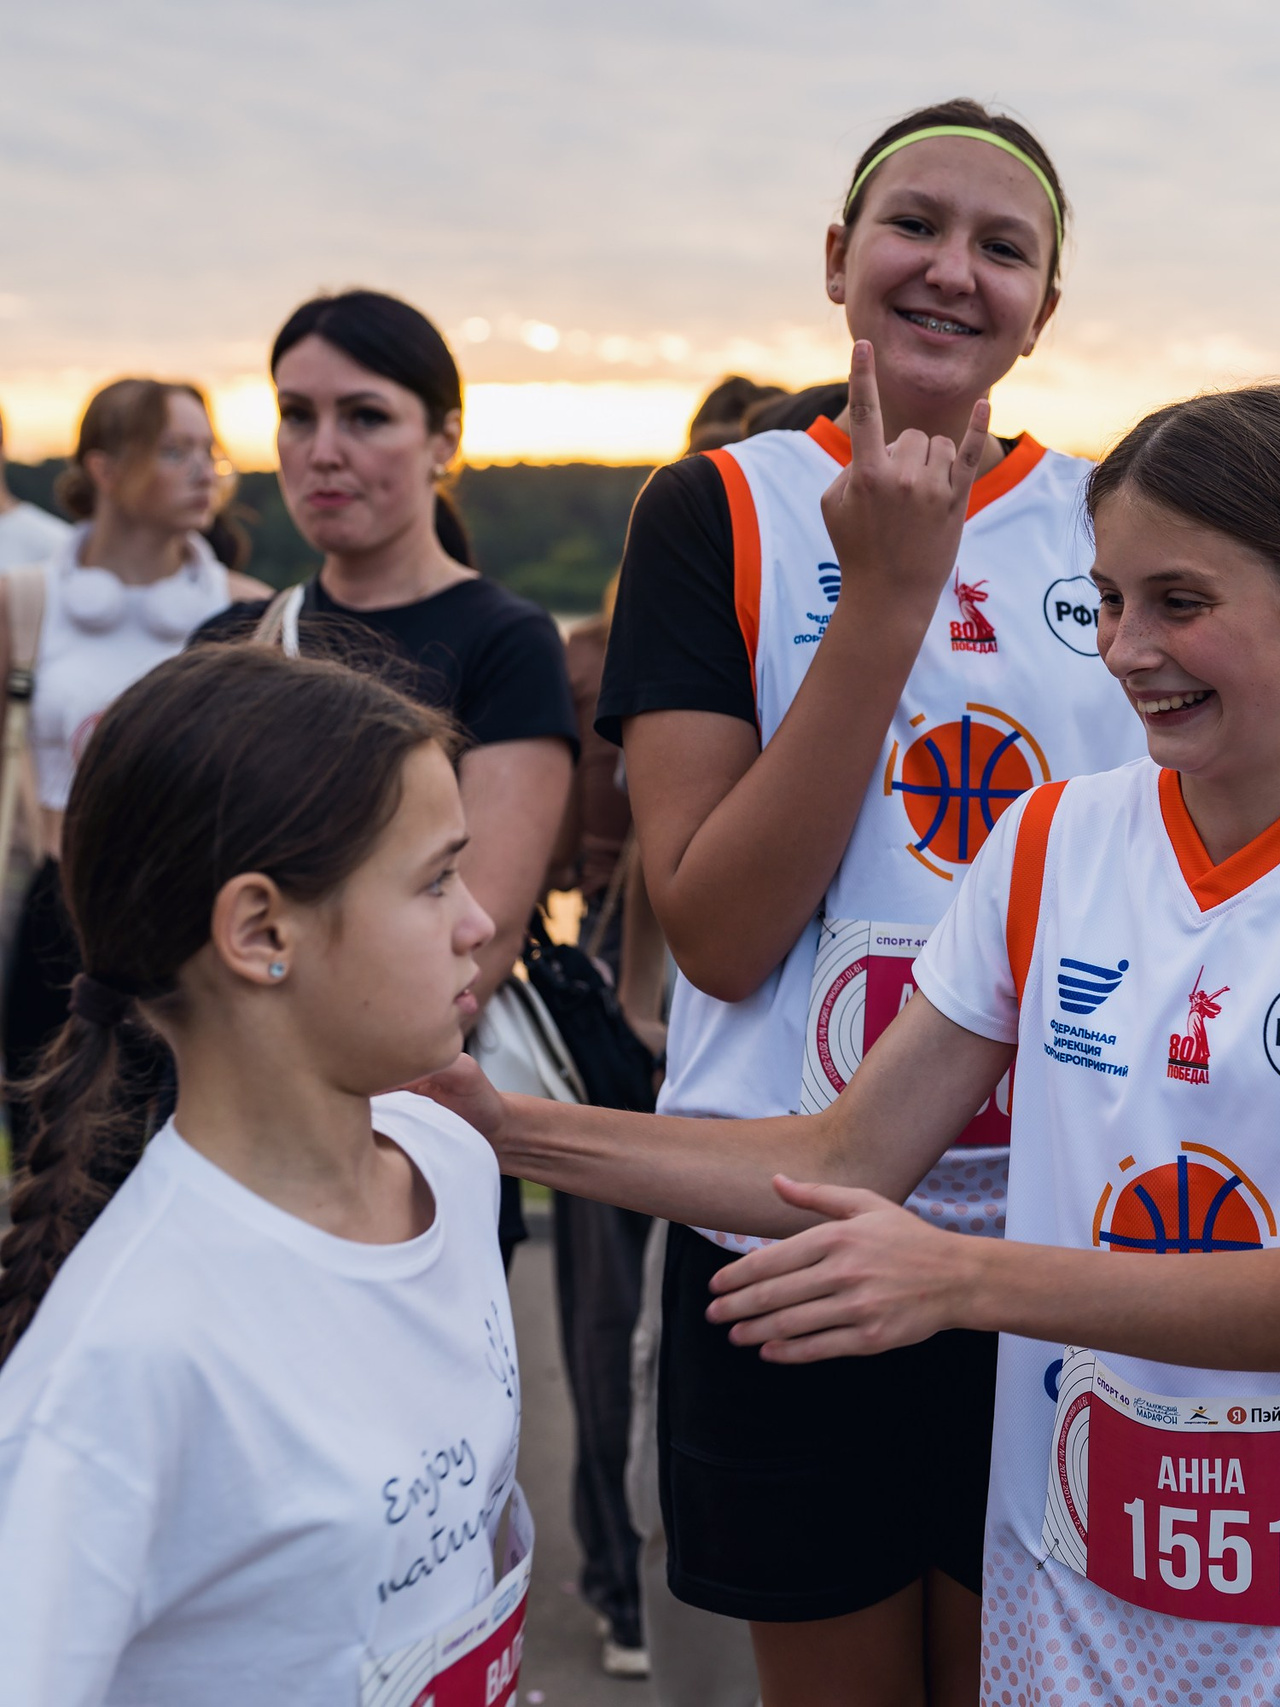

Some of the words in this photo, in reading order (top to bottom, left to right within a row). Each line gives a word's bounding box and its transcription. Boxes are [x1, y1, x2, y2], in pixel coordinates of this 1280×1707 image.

[950, 621, 974, 638] 80
[951, 641, 998, 653] ПОБЕДА!
[876, 936, 913, 947] СПОРТ
[818, 1040, 838, 1078] 2012-2013
[1169, 1033, 1195, 1061] 80
[1167, 1065, 1210, 1085] ПОБЕДА!
[1097, 1377, 1119, 1399] СПОРТ
[1119, 1394, 1130, 1405] 40
[1136, 1408, 1178, 1425] МАРАФОН
[382, 1437, 478, 1526] Enjoy
[1058, 1462, 1071, 1505] 2012-2013
[1157, 1455, 1246, 1494] АННА
